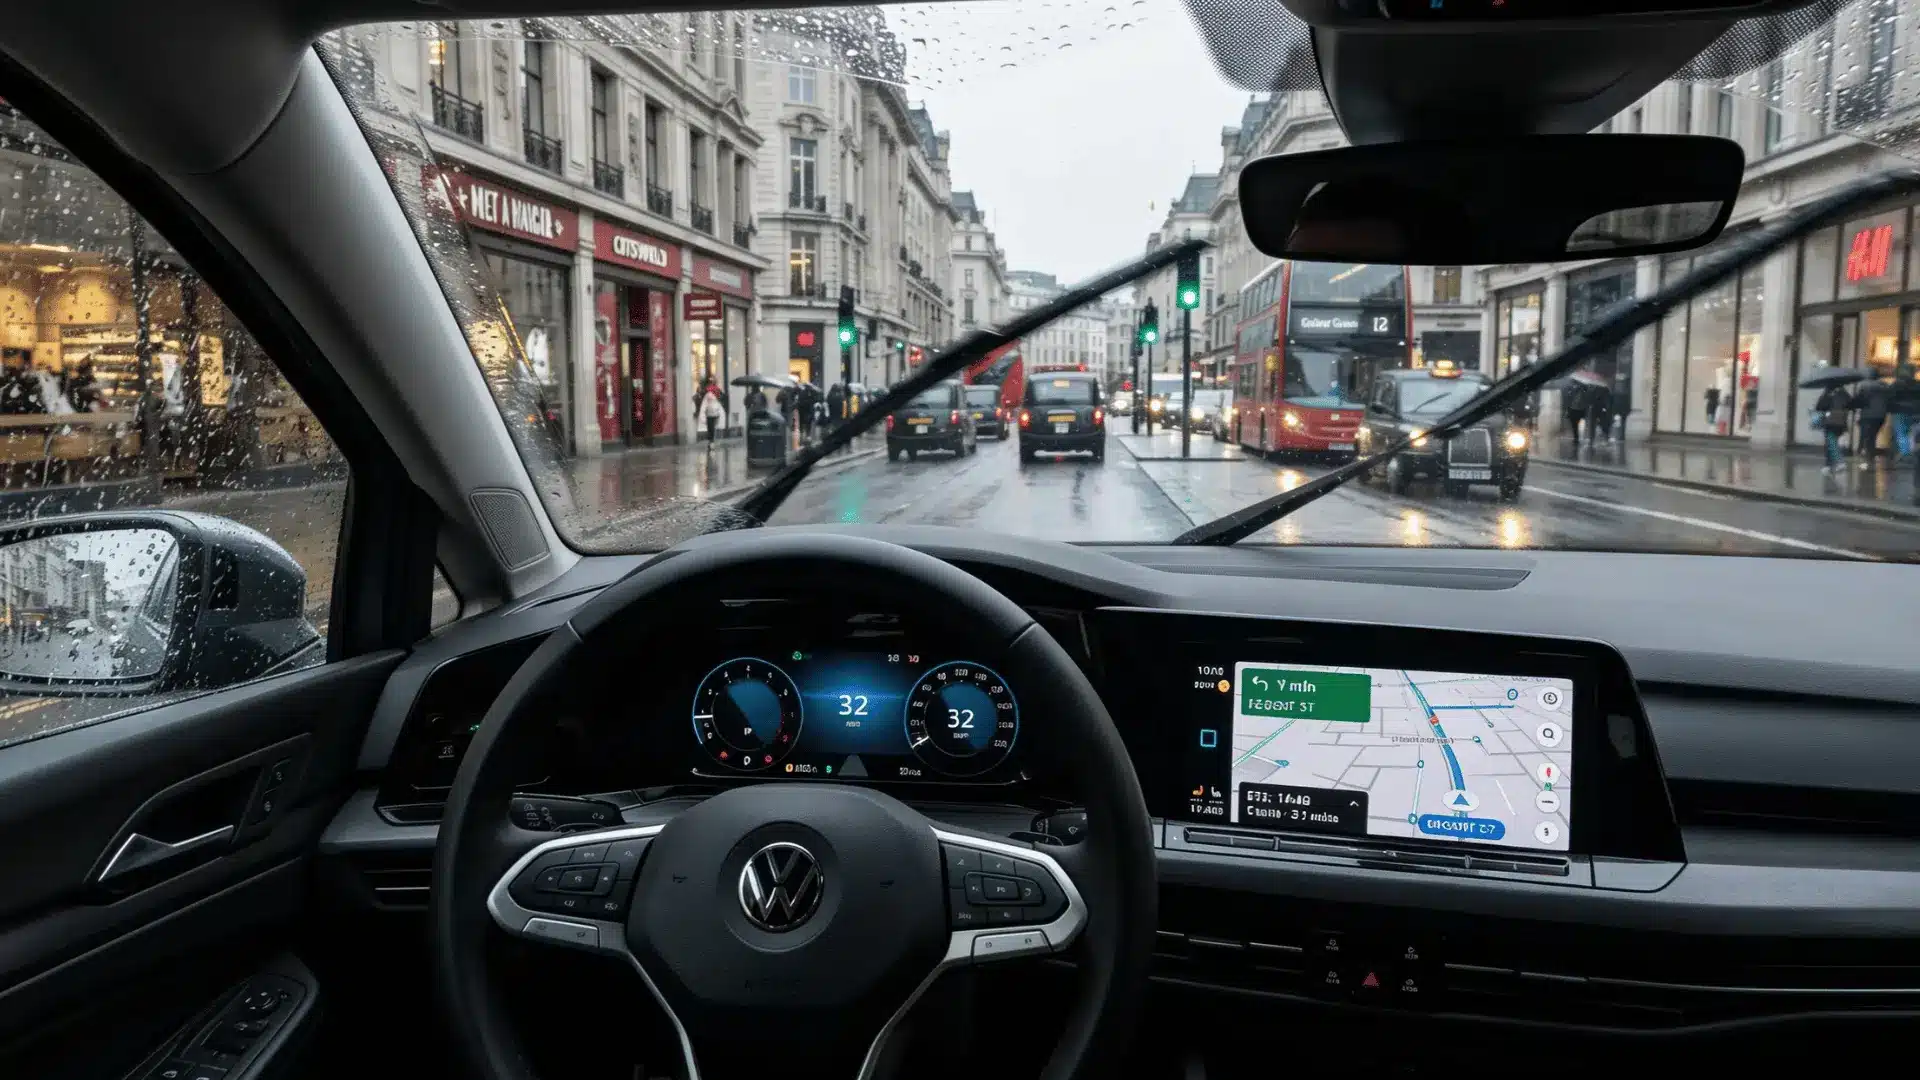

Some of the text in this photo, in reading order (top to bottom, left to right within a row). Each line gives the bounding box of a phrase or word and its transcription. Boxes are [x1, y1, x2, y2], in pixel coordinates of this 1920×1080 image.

[1373, 316, 1389, 332] 12
[838, 694, 868, 716] 32
[947, 708, 975, 729] 32
